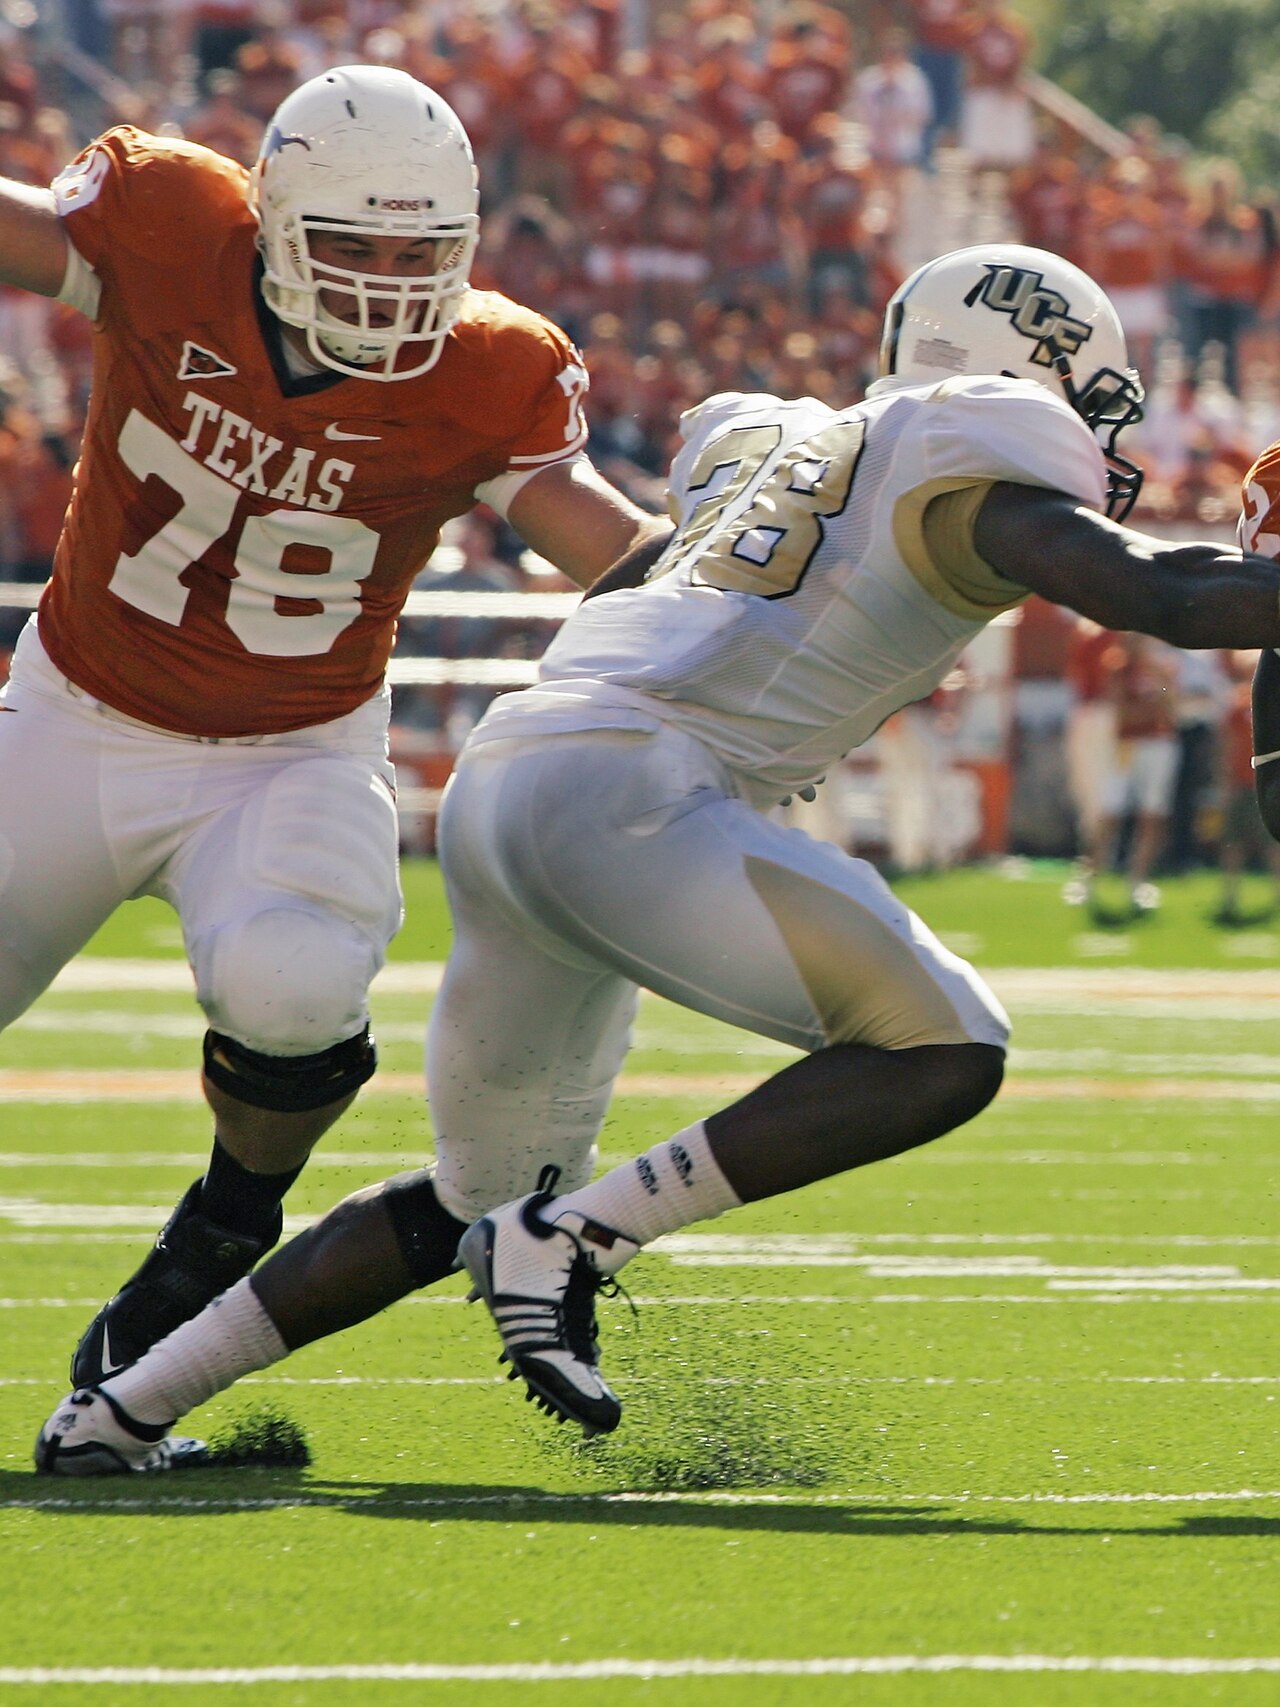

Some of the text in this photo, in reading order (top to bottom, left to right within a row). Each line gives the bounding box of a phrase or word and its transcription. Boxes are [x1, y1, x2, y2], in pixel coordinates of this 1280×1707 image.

[963, 264, 1093, 368] UCF
[179, 391, 356, 512] TEXAS
[555, 362, 590, 442] 7
[107, 408, 381, 657] 78
